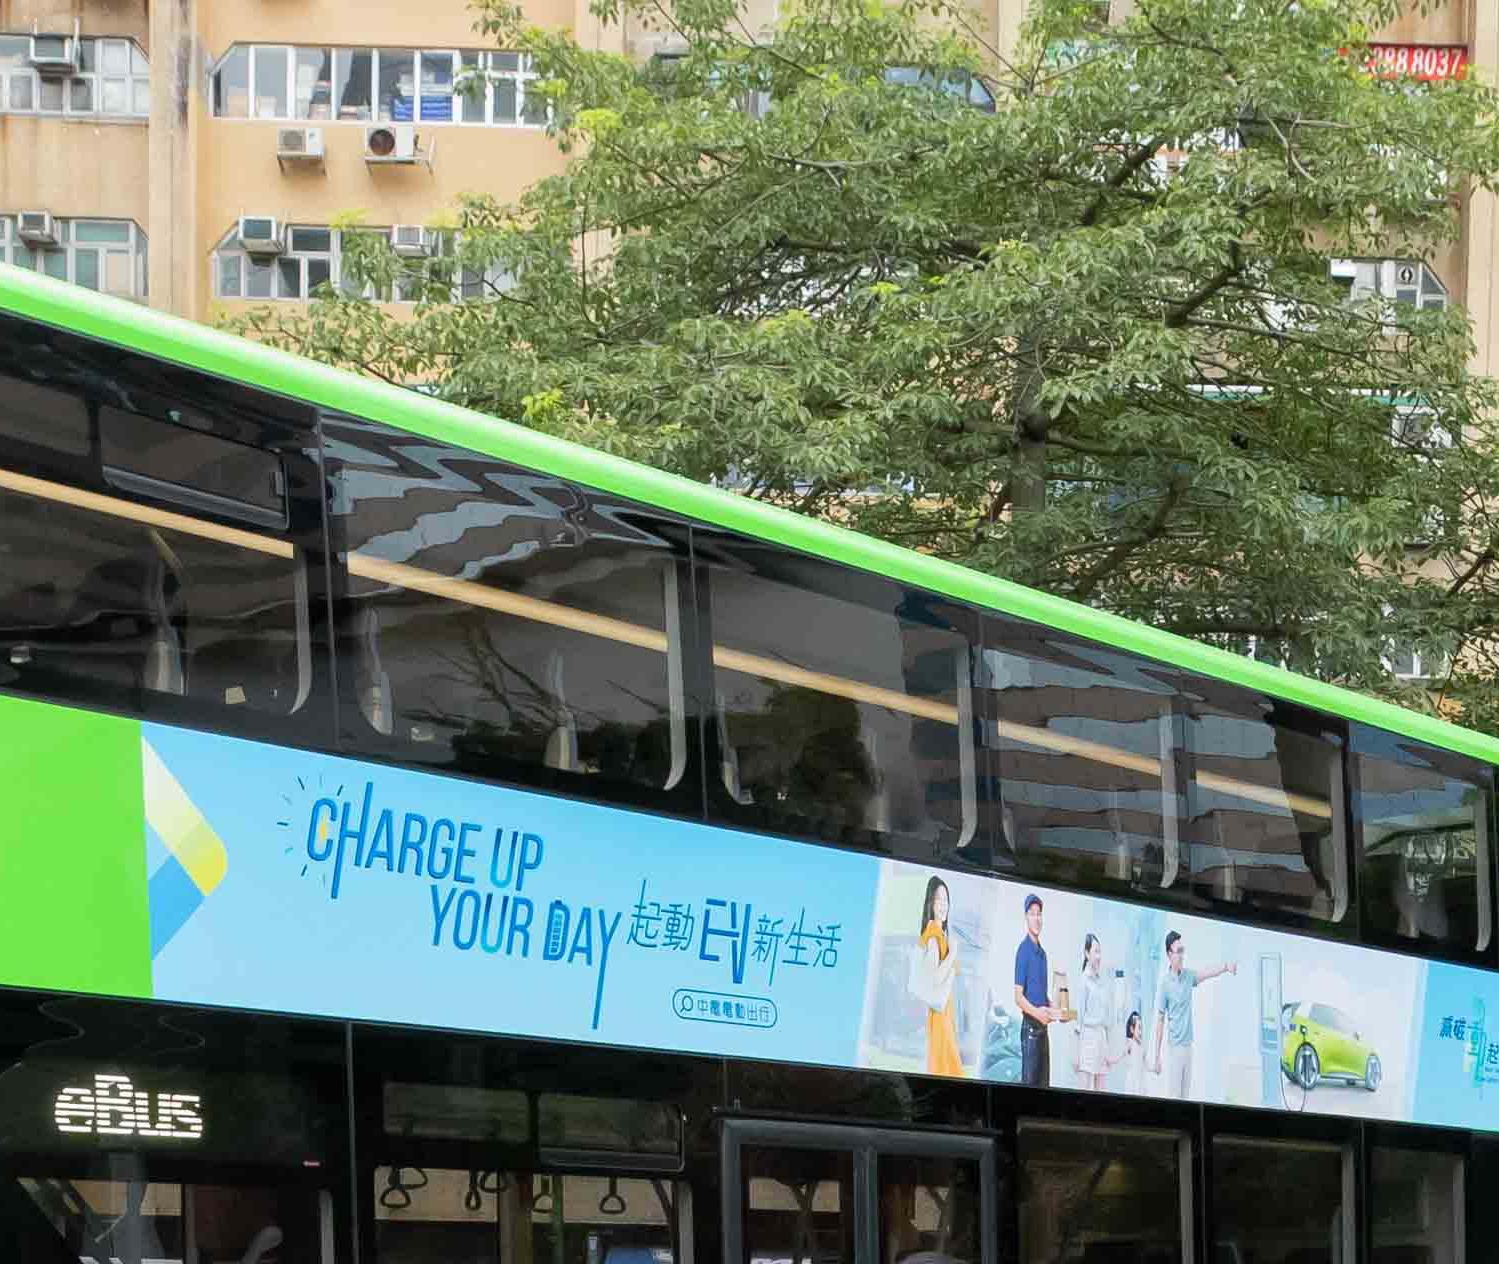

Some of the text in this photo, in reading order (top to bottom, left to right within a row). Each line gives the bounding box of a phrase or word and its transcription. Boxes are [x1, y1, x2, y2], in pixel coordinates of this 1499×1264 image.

[307, 781, 544, 899] CHARGE UP
[430, 885, 622, 1030] YOUR DAY
